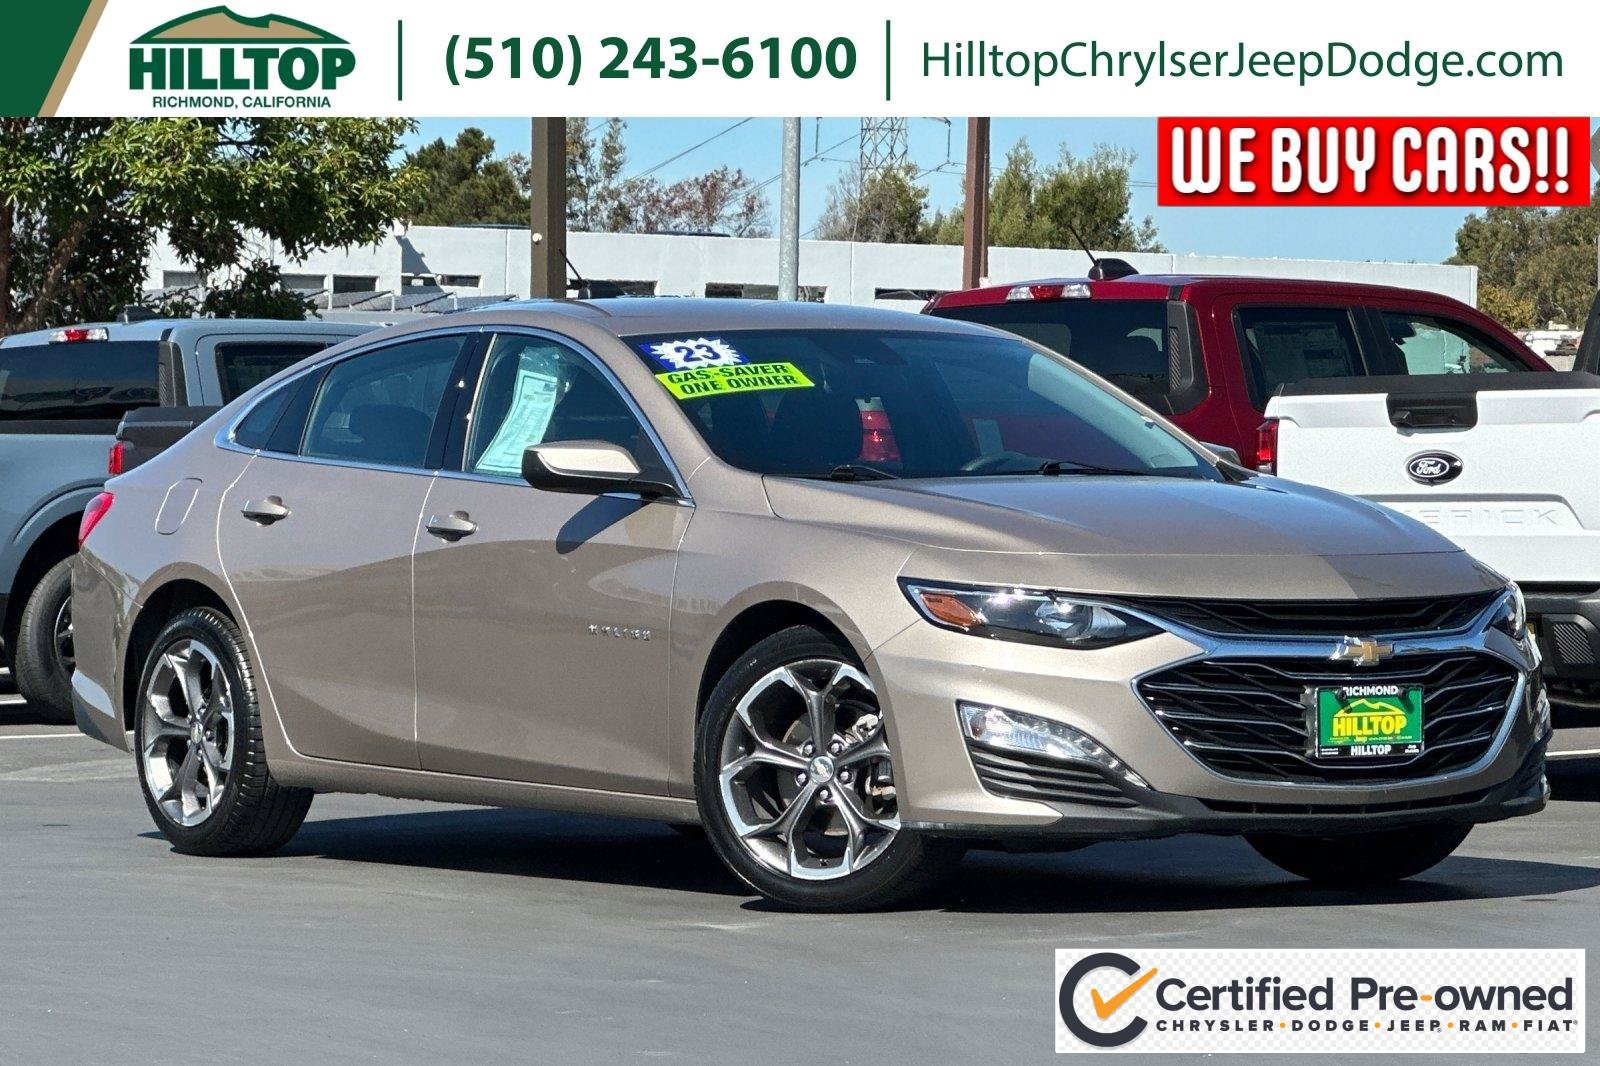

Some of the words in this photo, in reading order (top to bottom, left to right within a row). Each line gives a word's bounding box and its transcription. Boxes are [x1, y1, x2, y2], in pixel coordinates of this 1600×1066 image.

[674, 344, 722, 363] 23
[680, 380, 722, 395] ONE
[728, 375, 798, 389] OWNER
[1416, 459, 1442, 475] Ford
[1343, 685, 1399, 696] RICHMOND
[1333, 715, 1407, 737] HILLTOP
[1350, 744, 1392, 756] HILLTOP
